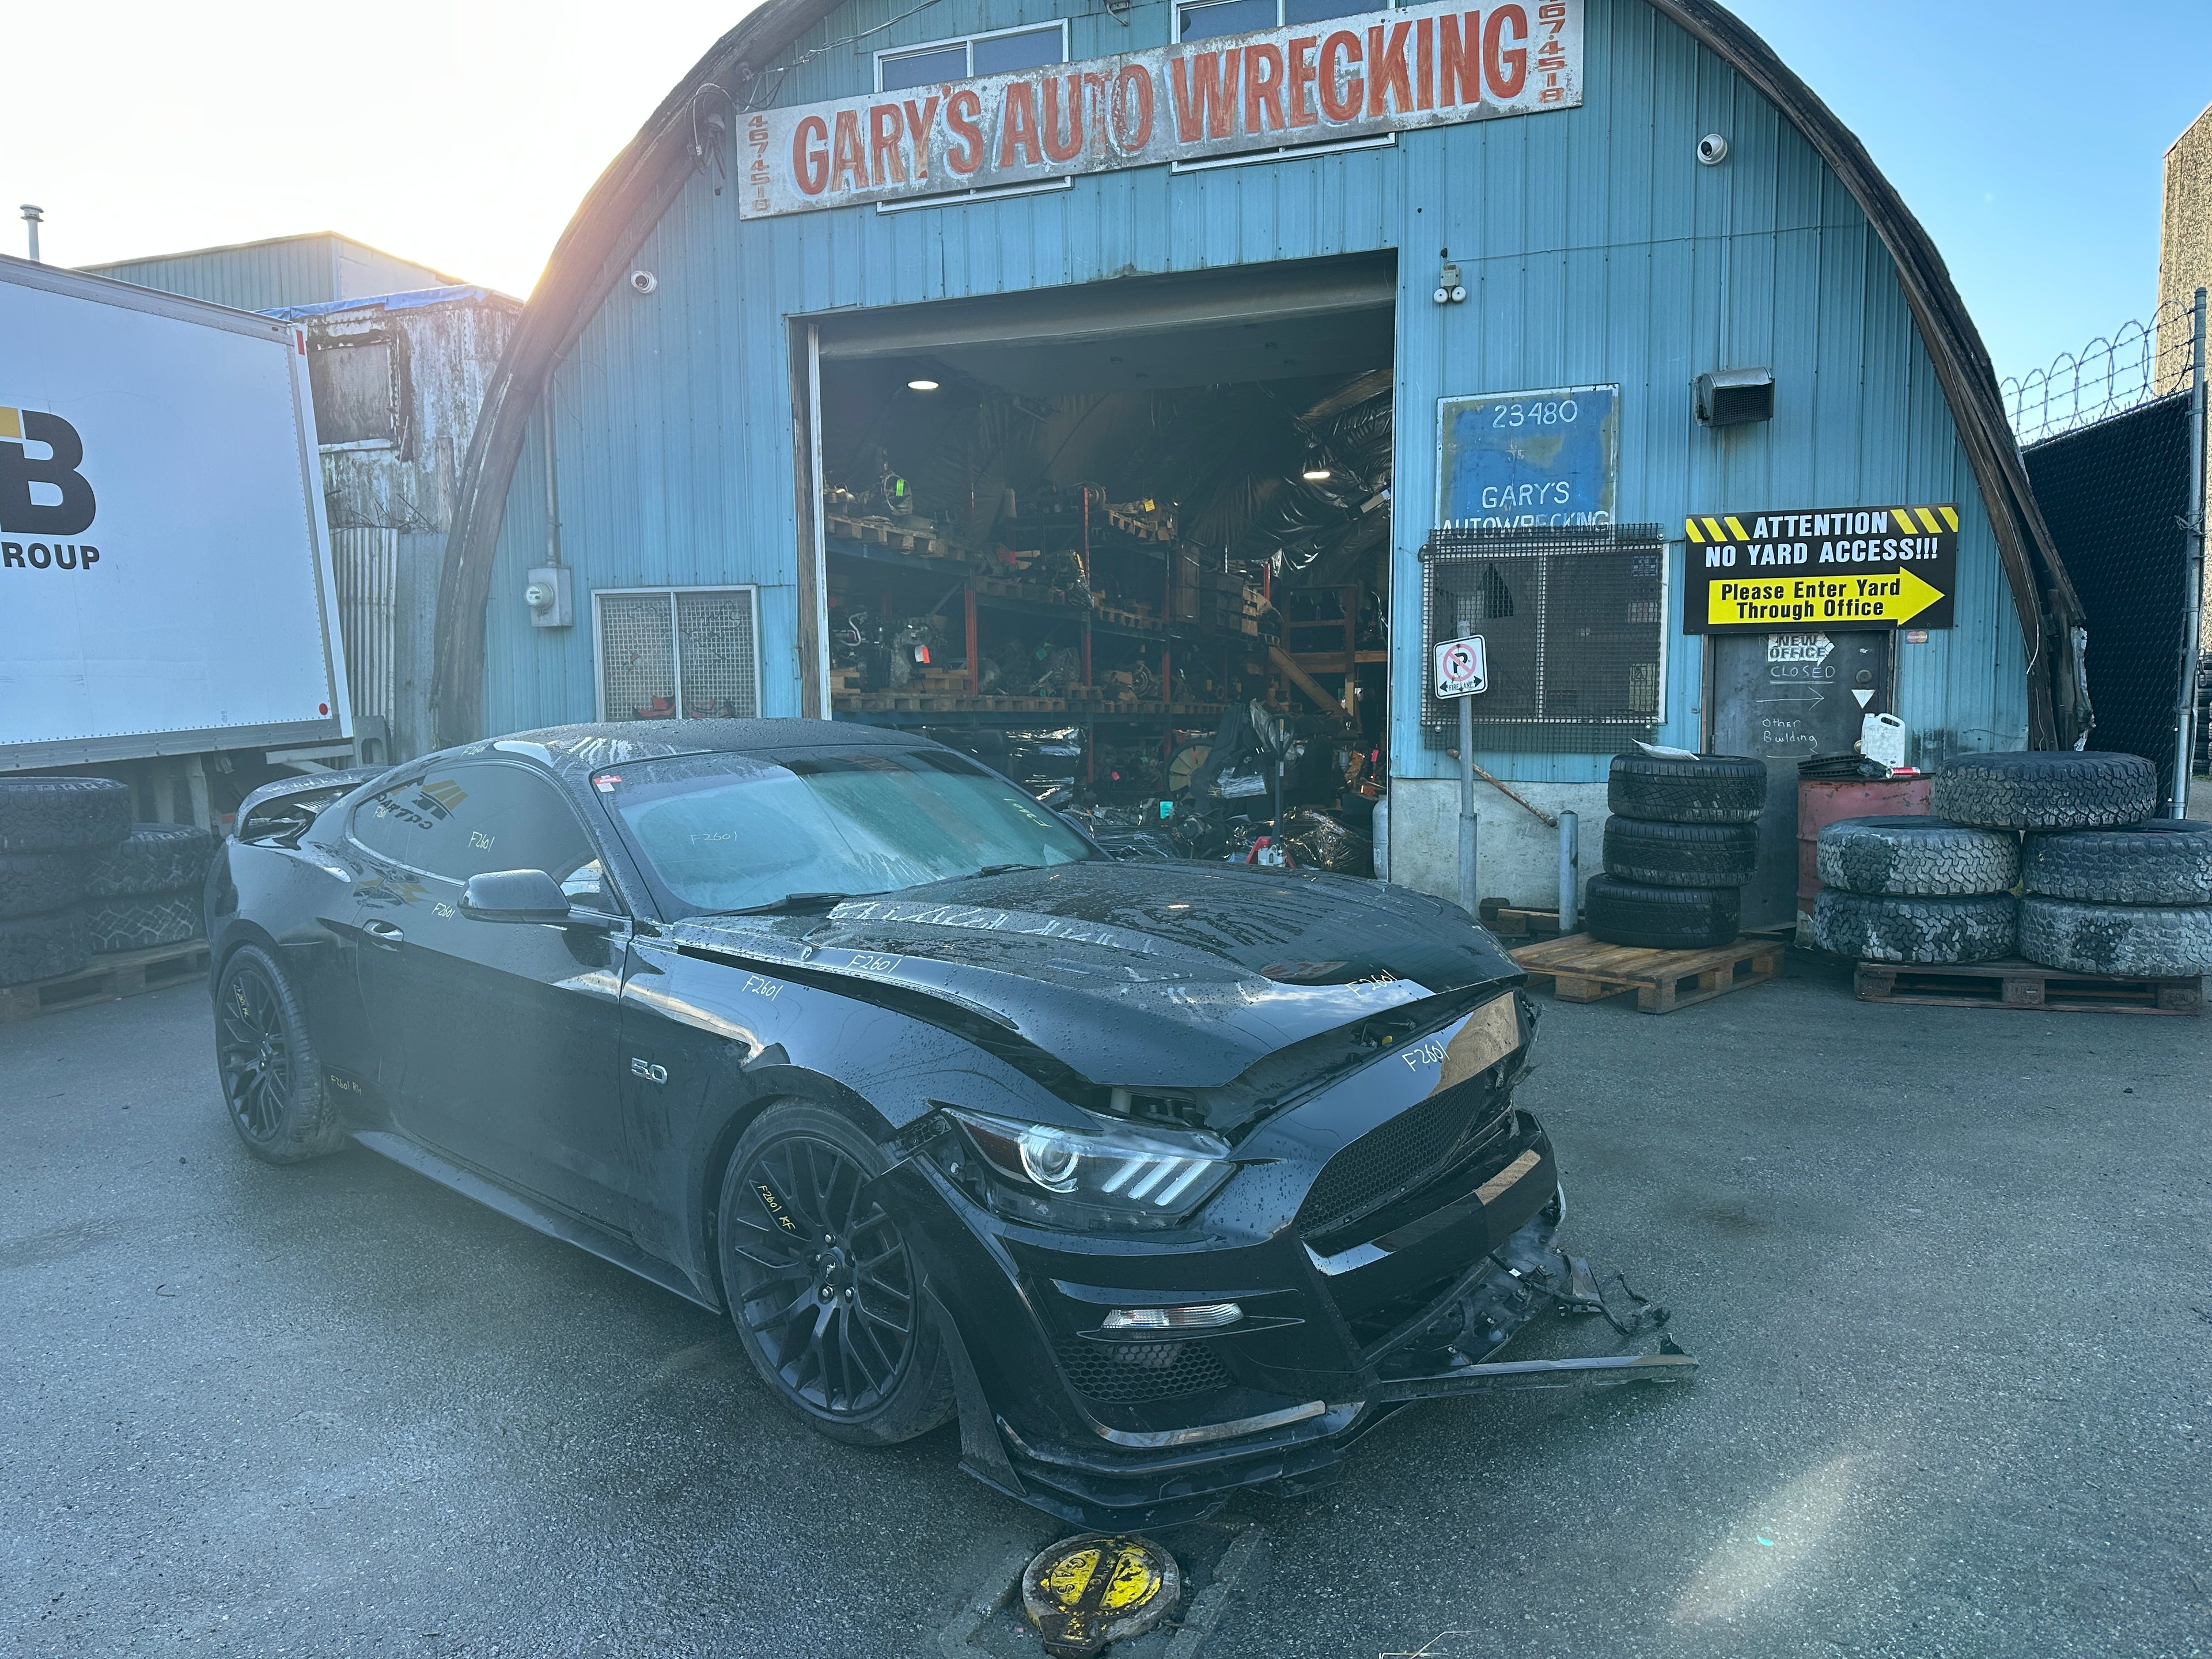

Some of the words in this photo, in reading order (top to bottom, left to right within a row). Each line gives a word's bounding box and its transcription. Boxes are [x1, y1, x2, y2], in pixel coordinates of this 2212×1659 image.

[792, 85, 981, 195] GARY'S
[999, 63, 1153, 168] AUTO
[1170, 4, 1528, 143] WRECKING
[1492, 399, 1578, 429] 23480
[1482, 481, 1570, 509] GARY'S
[1752, 511, 1888, 539] ATTENTION
[1705, 545, 1736, 568] NO
[1746, 542, 1808, 566] YARD
[1819, 537, 1938, 564] ACCESS!!!
[1721, 581, 1785, 601] Please
[1793, 579, 1847, 599] Enter
[1856, 578, 1901, 597] Yard
[1736, 600, 1815, 620] Through
[1823, 599, 1884, 617] Office
[1778, 634, 1817, 646] NEW
[1770, 646, 1826, 658] OFFICE
[1771, 665, 1835, 678] CLOSED
[1449, 683, 1459, 691] FIRE
[1763, 730, 1818, 749] Building
[468, 831, 495, 853] F2601
[690, 831, 737, 844] F2601
[431, 902, 455, 921] F2601
[846, 954, 902, 974] F2601
[741, 975, 784, 1001] F2601
[1344, 969, 1397, 998] F2601
[1402, 1040, 1450, 1072] F2601
[331, 1075, 350, 1091] F2601
[757, 1185, 782, 1213] F2601
